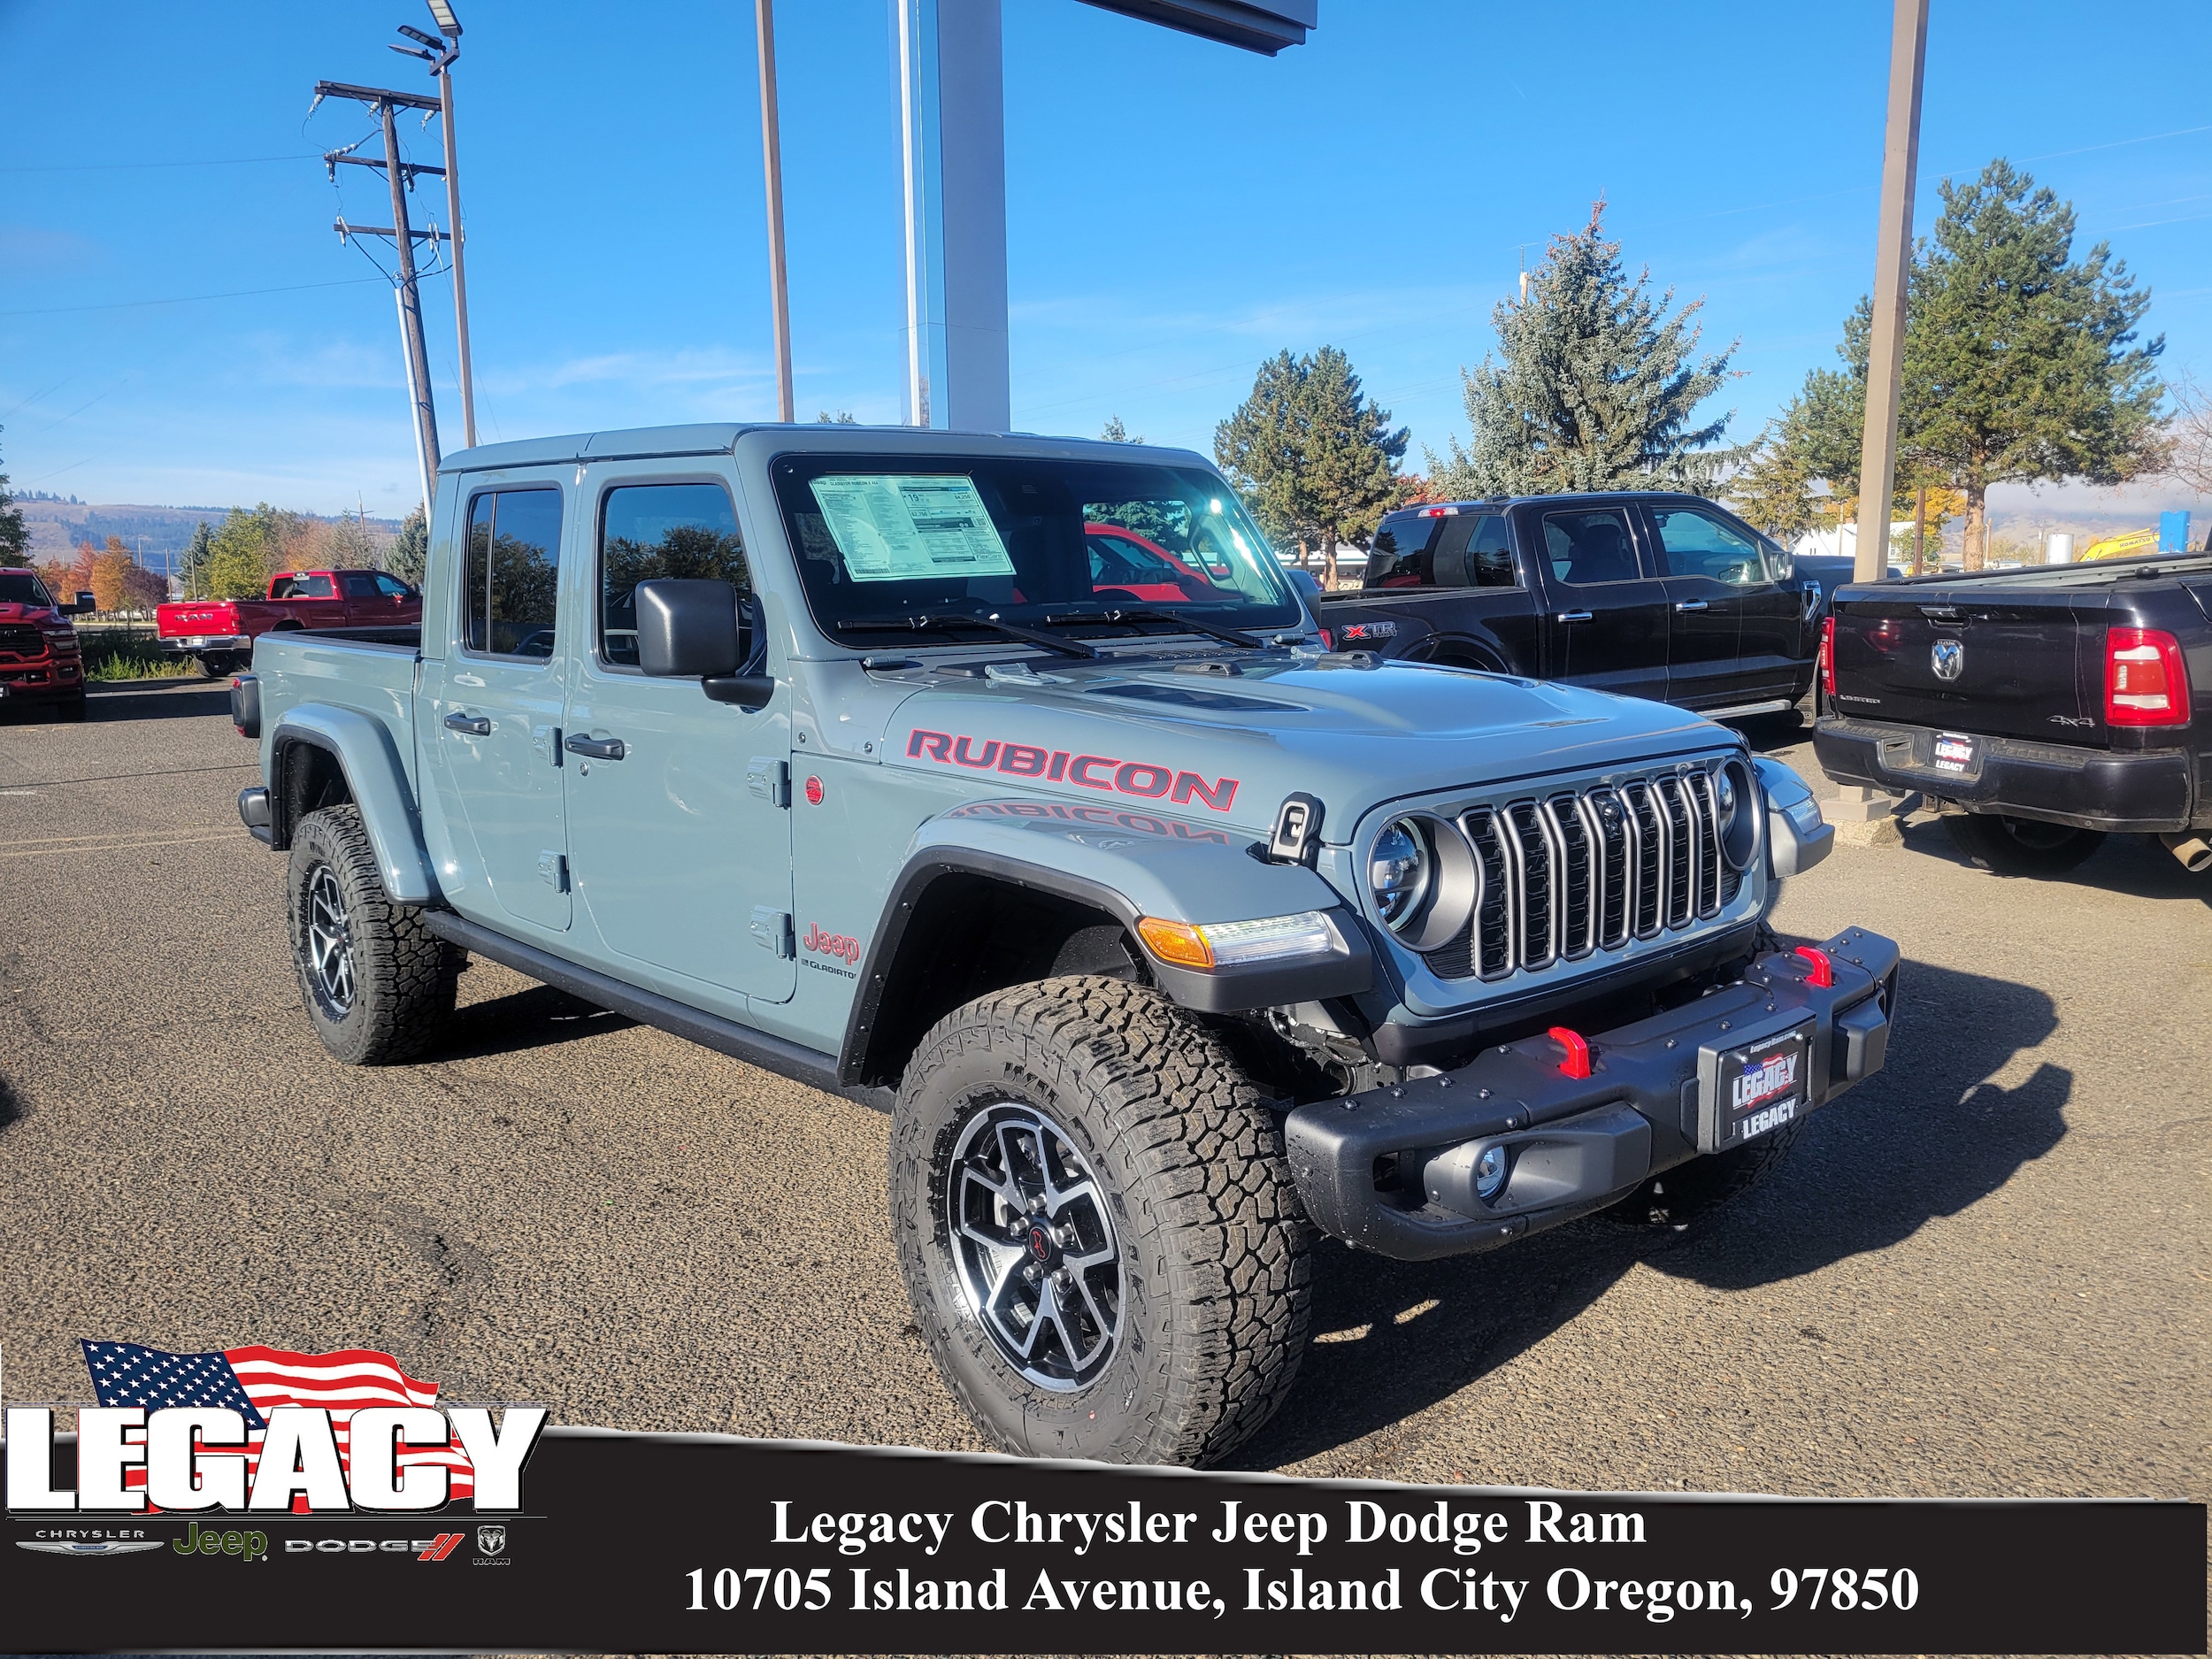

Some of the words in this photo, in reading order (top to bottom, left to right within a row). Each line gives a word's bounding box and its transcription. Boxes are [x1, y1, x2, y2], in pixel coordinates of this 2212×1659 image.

[2119, 536, 2151, 548] KOMATSU
[174, 613, 213, 622] RAM
[905, 727, 1240, 812] RUBICON
[1935, 759, 1965, 772] LEGACY
[803, 921, 860, 966] Jeep
[1732, 1055, 1798, 1108] LEGACY
[1742, 1098, 1797, 1140] LEGACY
